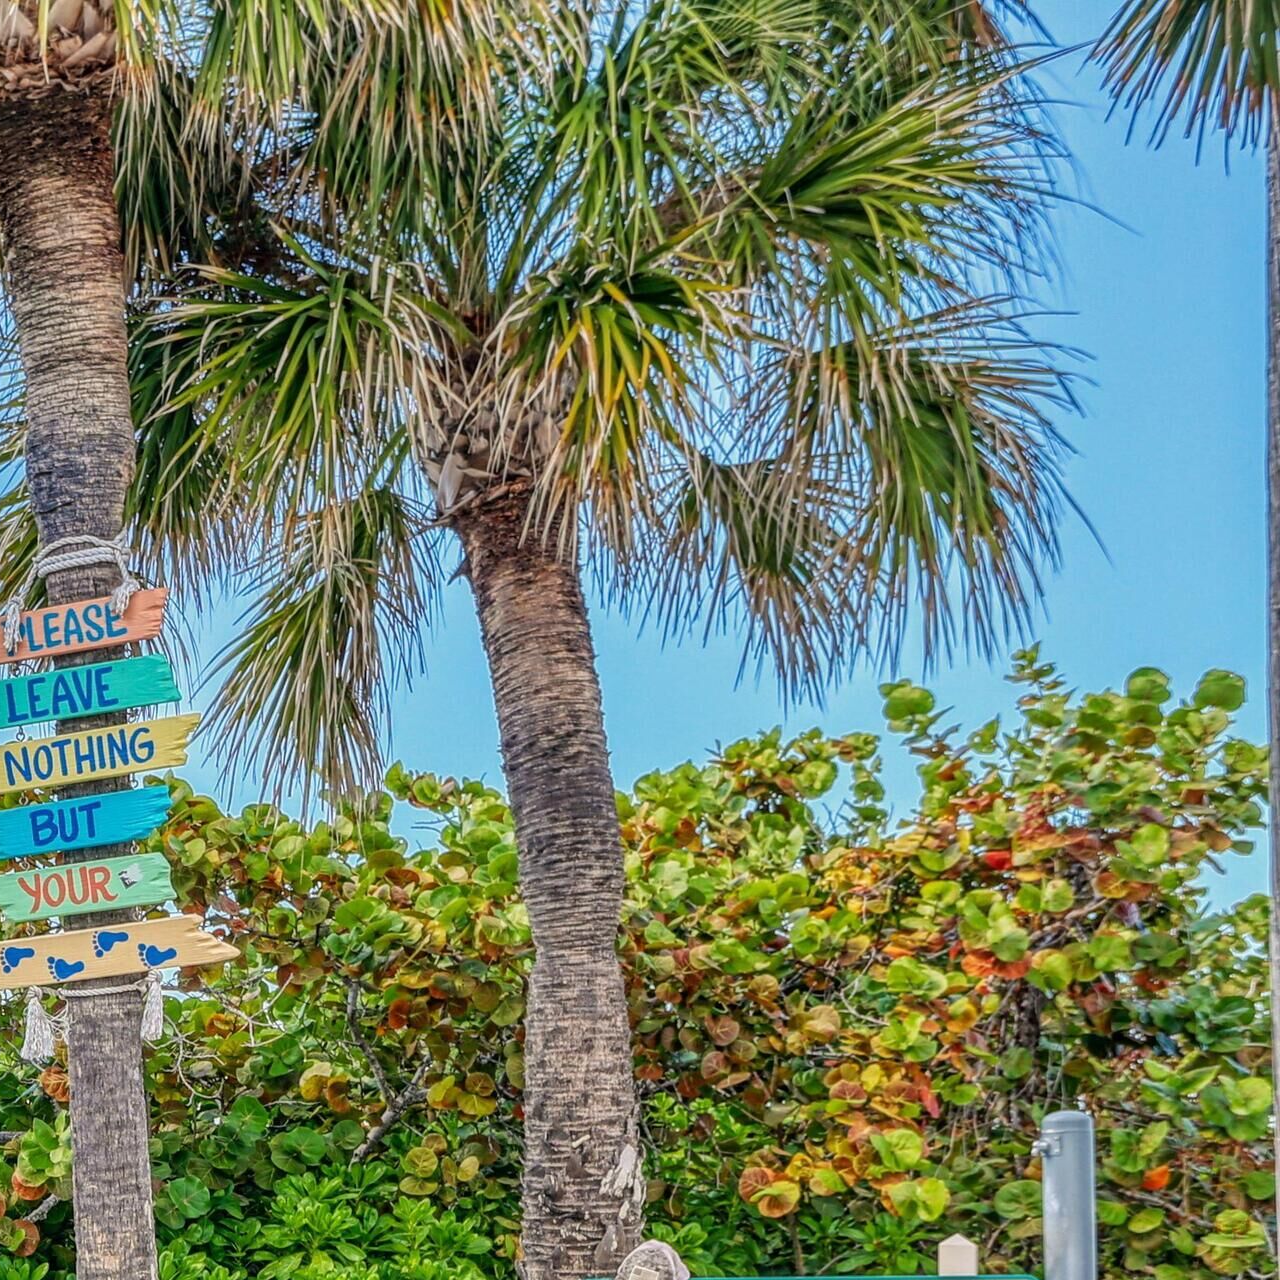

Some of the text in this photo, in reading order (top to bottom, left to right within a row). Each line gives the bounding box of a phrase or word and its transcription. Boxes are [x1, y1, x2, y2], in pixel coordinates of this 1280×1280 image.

[4, 666, 120, 723] LEAVE
[4, 726, 156, 786] NOTHING
[30, 800, 102, 846] BUT
[18, 864, 118, 914] YOUR
